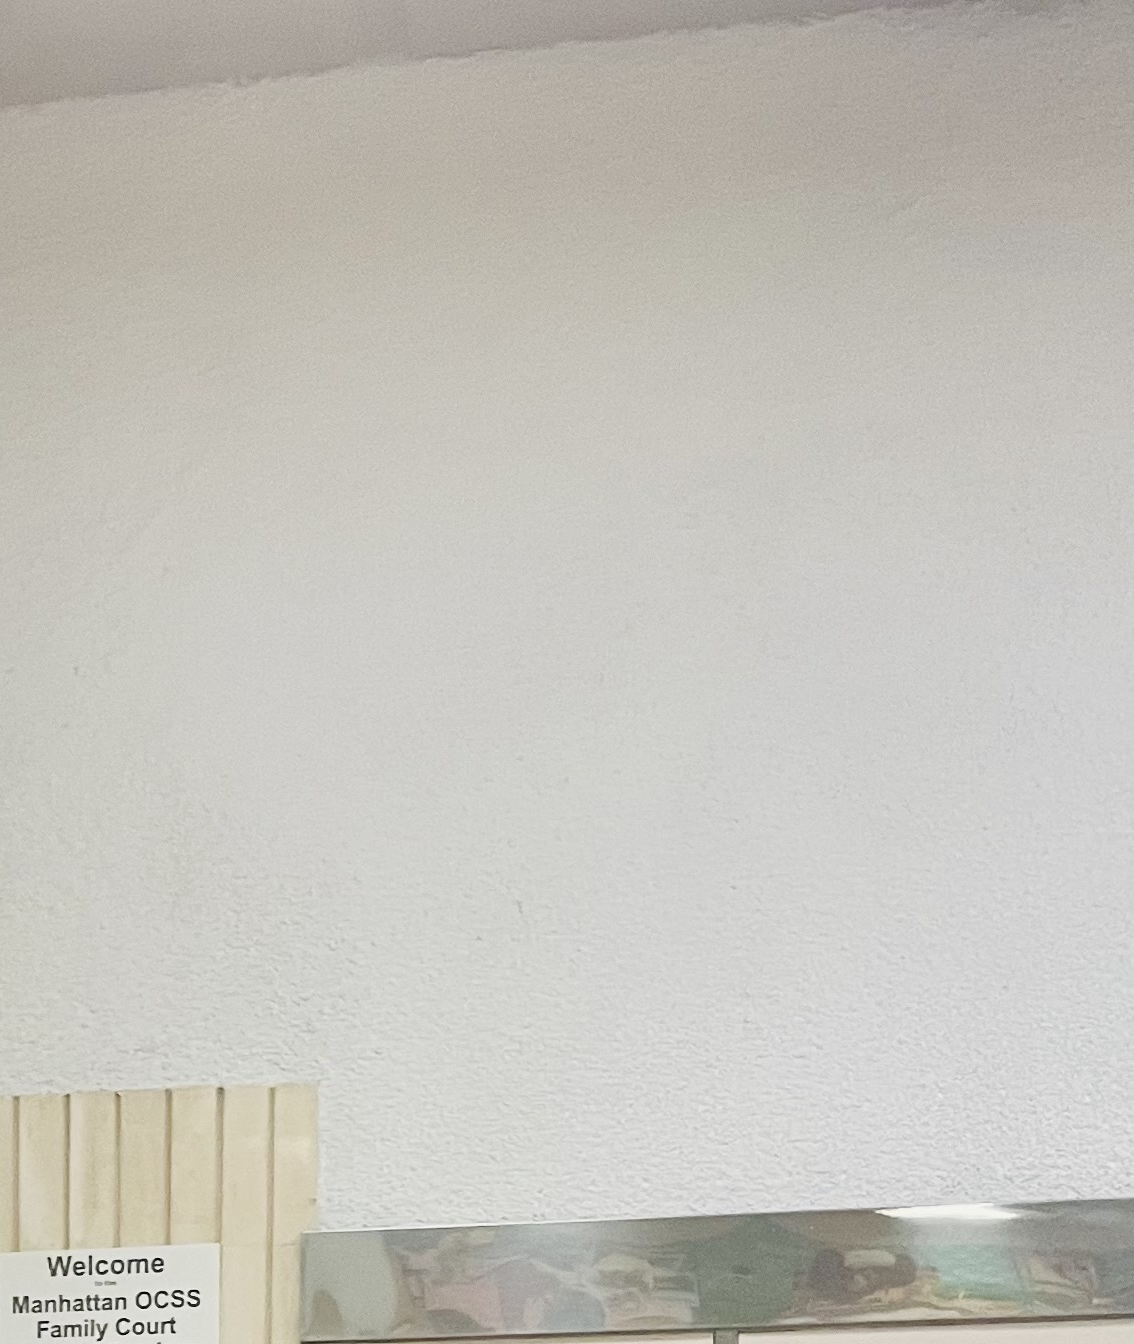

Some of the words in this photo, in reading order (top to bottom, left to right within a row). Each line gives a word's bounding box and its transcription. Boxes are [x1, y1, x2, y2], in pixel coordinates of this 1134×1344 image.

[47, 1255, 165, 1277] Welcome
[12, 1294, 127, 1314] Manhattan
[135, 1289, 201, 1310] OCSS
[37, 1319, 108, 1341] Family
[115, 1317, 176, 1336] Court
